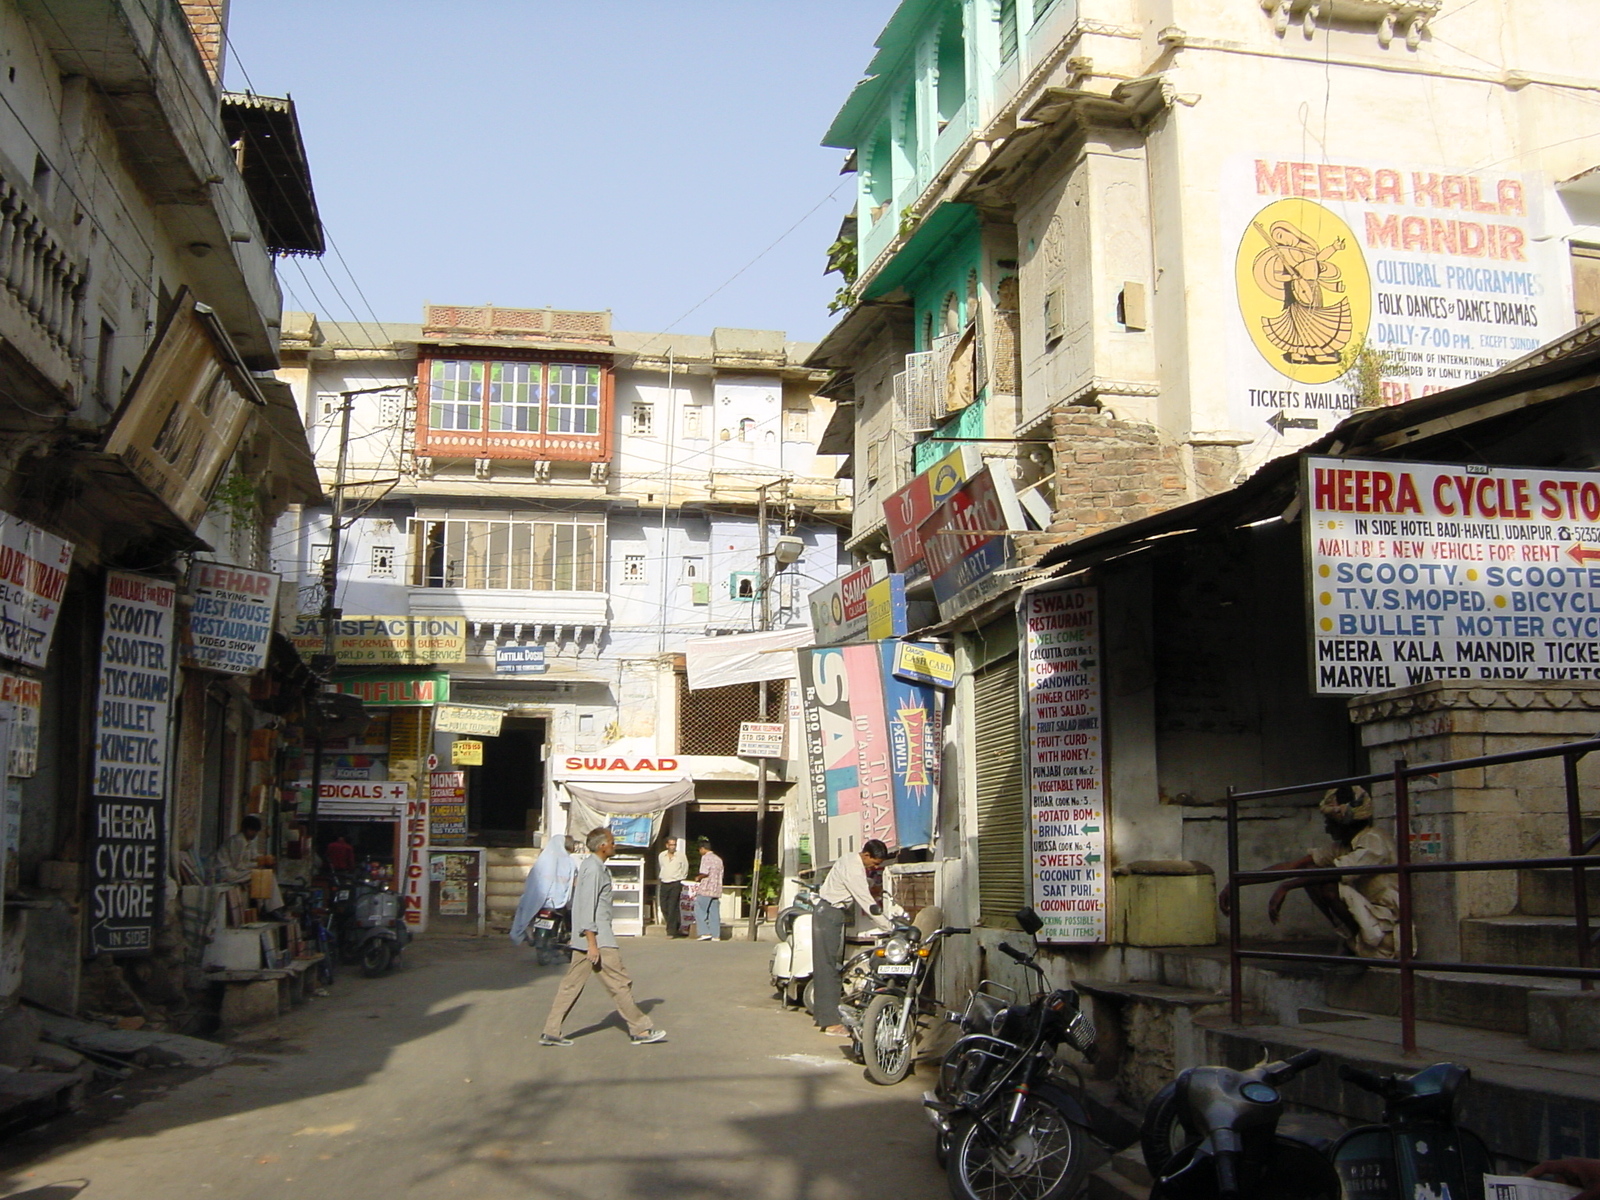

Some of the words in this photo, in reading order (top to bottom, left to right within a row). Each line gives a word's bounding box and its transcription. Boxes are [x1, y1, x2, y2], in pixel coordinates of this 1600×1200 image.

[1255, 159, 1400, 204] MEERA
[1412, 172, 1526, 216] KALA
[1365, 212, 1526, 261] MANDIR
[1377, 261, 1440, 288] CULTURAL
[1378, 293, 1402, 316] FOLK
[1406, 297, 1447, 319] DANCES
[1457, 298, 1491, 324] DANCE
[1494, 303, 1538, 327] DRAMAS
[1481, 335, 1507, 348] EXCEPT
[1510, 338, 1540, 351] SUNDAY
[1426, 354, 1435, 362] OF
[1438, 355, 1494, 367] INTERNATIONAL
[1427, 367, 1435, 377] BY
[1440, 368, 1460, 378] LONLY
[1249, 389, 1300, 408] TICKETS
[1314, 468, 1424, 515] HEERA
[1432, 475, 1533, 520] CYCLE
[1356, 520, 1368, 535] IN
[1372, 520, 1397, 536] SIDE
[1402, 521, 1435, 537] HOTEL
[1393, 541, 1424, 559] NEW
[1431, 542, 1484, 561] VEHICLE
[1489, 544, 1516, 561] FOR
[1522, 545, 1560, 563] RENT
[199, 566, 272, 596] LEHAR
[108, 577, 145, 602] AVAILABLE
[146, 587, 156, 601] FOR
[157, 586, 175, 608] RENT
[215, 590, 247, 603] PAYING
[1033, 593, 1085, 613] SWAAD
[229, 602, 272, 624] HOUSE
[1029, 611, 1094, 632] RESTAURANT
[190, 616, 270, 644] RESTAURANT
[1340, 614, 1444, 636] BULLET
[1457, 616, 1544, 637] MOTER
[199, 636, 227, 647] VIDEO
[229, 641, 256, 652] SHOW
[342, 639, 412, 648] INFORMATION
[418, 639, 457, 648] BUREAU
[1320, 640, 1383, 662] MEERA
[1393, 641, 1444, 662] KALA
[1456, 641, 1535, 663] MANDIR
[367, 650, 375, 660] &
[379, 650, 420, 660] TRAVEL
[422, 650, 461, 659] SERVICE
[1030, 647, 1062, 660] CALCUTTA
[905, 654, 926, 665] CASH
[929, 660, 951, 672] CARD
[104, 668, 127, 699] TVS
[1320, 666, 1396, 688] MARVEL
[1406, 666, 1471, 687] WATER
[1036, 691, 1062, 705] FINGER
[809, 707, 820, 731] 100
[1037, 706, 1057, 719] WITH
[1037, 721, 1055, 733] FRUIT
[1057, 719, 1075, 732] SALAD
[812, 738, 823, 754] TO
[894, 725, 907, 768] TIMEX
[903, 710, 924, 782] PATAAKA
[924, 725, 934, 768] OFFER
[565, 757, 678, 772] SWAAD
[1038, 751, 1059, 763] WITH
[431, 773, 464, 788] MONEY
[814, 759, 826, 793] 1500
[1033, 765, 1061, 779] PUNJABI
[1063, 766, 1078, 776] COOK
[319, 784, 387, 800] EDICALS.
[857, 741, 872, 843] Anniversar
[1038, 779, 1073, 793] VEGETABLE
[869, 753, 894, 843] TITAN
[1034, 796, 1053, 808] BIHAR
[1055, 796, 1070, 807] COOK
[818, 799, 827, 823] OFF
[1039, 810, 1070, 823] POTATO
[98, 803, 156, 840] HEERA
[1059, 842, 1073, 851] COOK
[96, 844, 155, 880] CYCLE
[404, 801, 426, 925] MEDICINE
[1040, 870, 1082, 881] COCONUT
[1086, 869, 1095, 880] KI
[1043, 885, 1067, 896] SAAT
[95, 884, 154, 919] STORE
[1041, 900, 1076, 911] COCONUT
[1041, 916, 1062, 925] ACKING
[1064, 916, 1094, 925] POSSIBLE
[109, 931, 121, 945] IN
[125, 930, 147, 946] SIDE
[1045, 927, 1057, 937] FOR
[1060, 927, 1070, 937] ALL
